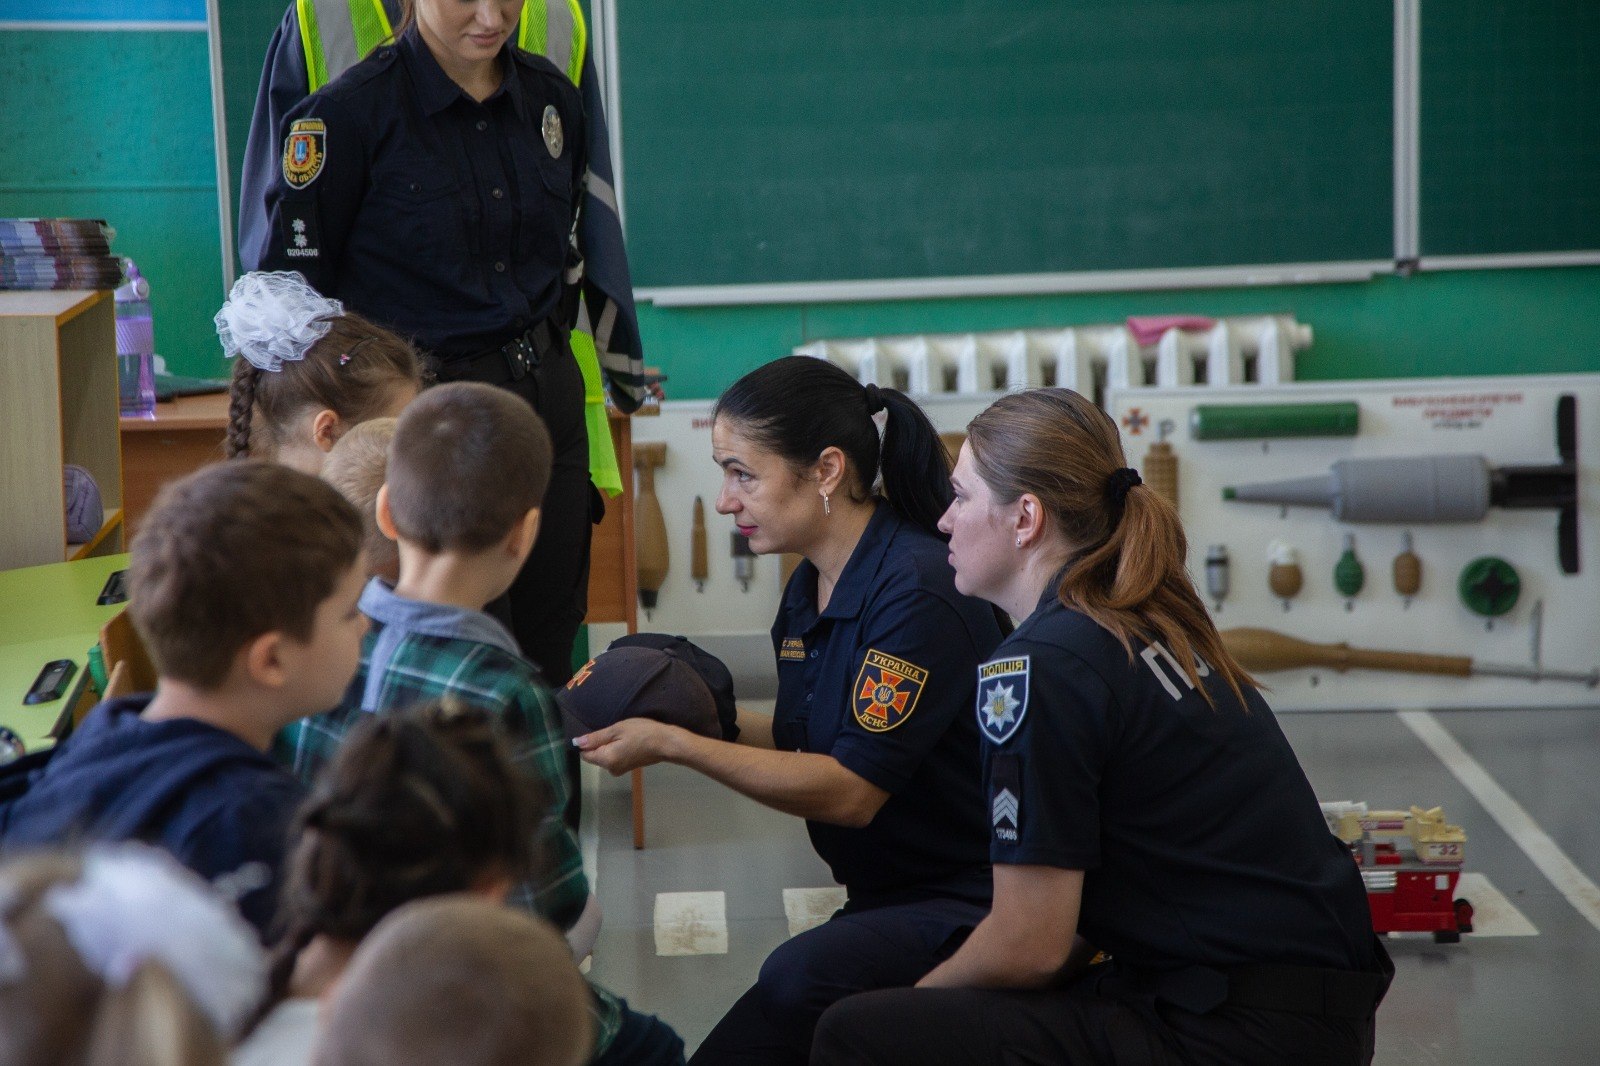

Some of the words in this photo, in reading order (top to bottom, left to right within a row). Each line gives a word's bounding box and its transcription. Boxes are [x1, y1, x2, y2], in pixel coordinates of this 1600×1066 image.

[299, 151, 322, 182] ОБЛАСТЬ
[873, 654, 920, 680] УКРАЇНА
[983, 660, 1024, 678] ПОЛІЦІЯ
[860, 713, 888, 728] ДСНС
